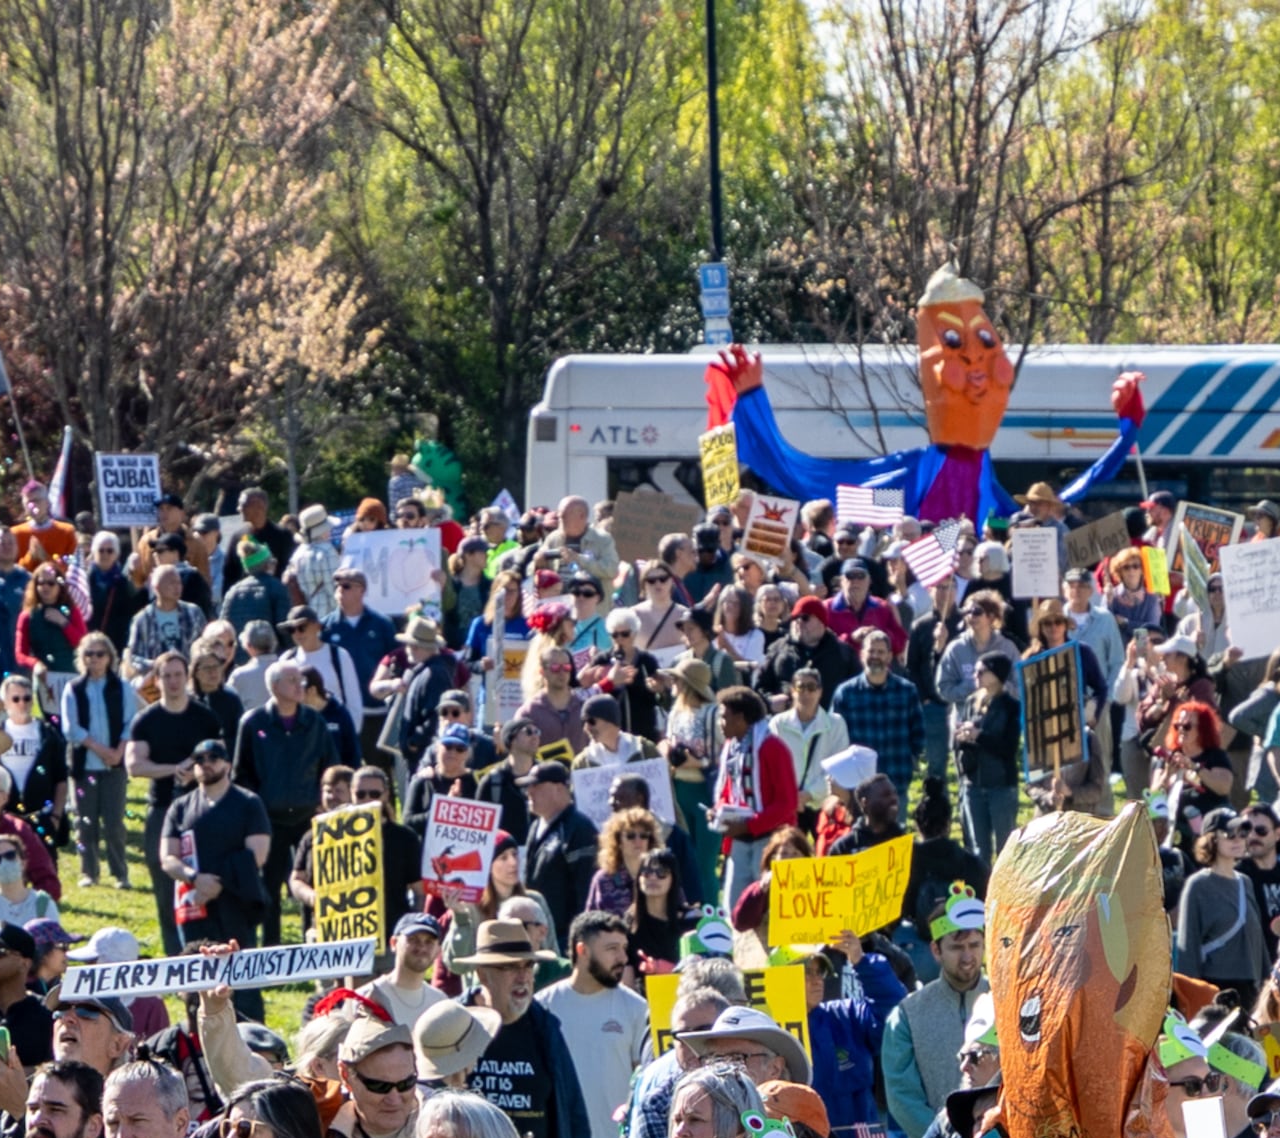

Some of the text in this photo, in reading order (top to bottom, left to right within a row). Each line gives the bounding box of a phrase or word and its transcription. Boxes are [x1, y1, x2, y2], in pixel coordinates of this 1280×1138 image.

[103, 468, 156, 489] CUBA!
[106, 491, 157, 504] END THE
[317, 811, 375, 841] NO
[435, 802, 493, 829] RESIST
[435, 824, 488, 845] FASCISM
[320, 838, 377, 886] KINGS
[320, 886, 377, 917] NO
[852, 871, 902, 912] PEACE
[321, 909, 379, 943] WARS
[74, 943, 372, 995] MERRY MEN AGAINST TYRANNY
[480, 1060, 535, 1076] ATLANTA
[486, 1076, 498, 1090] IT
[486, 1093, 531, 1109] EAVEN
